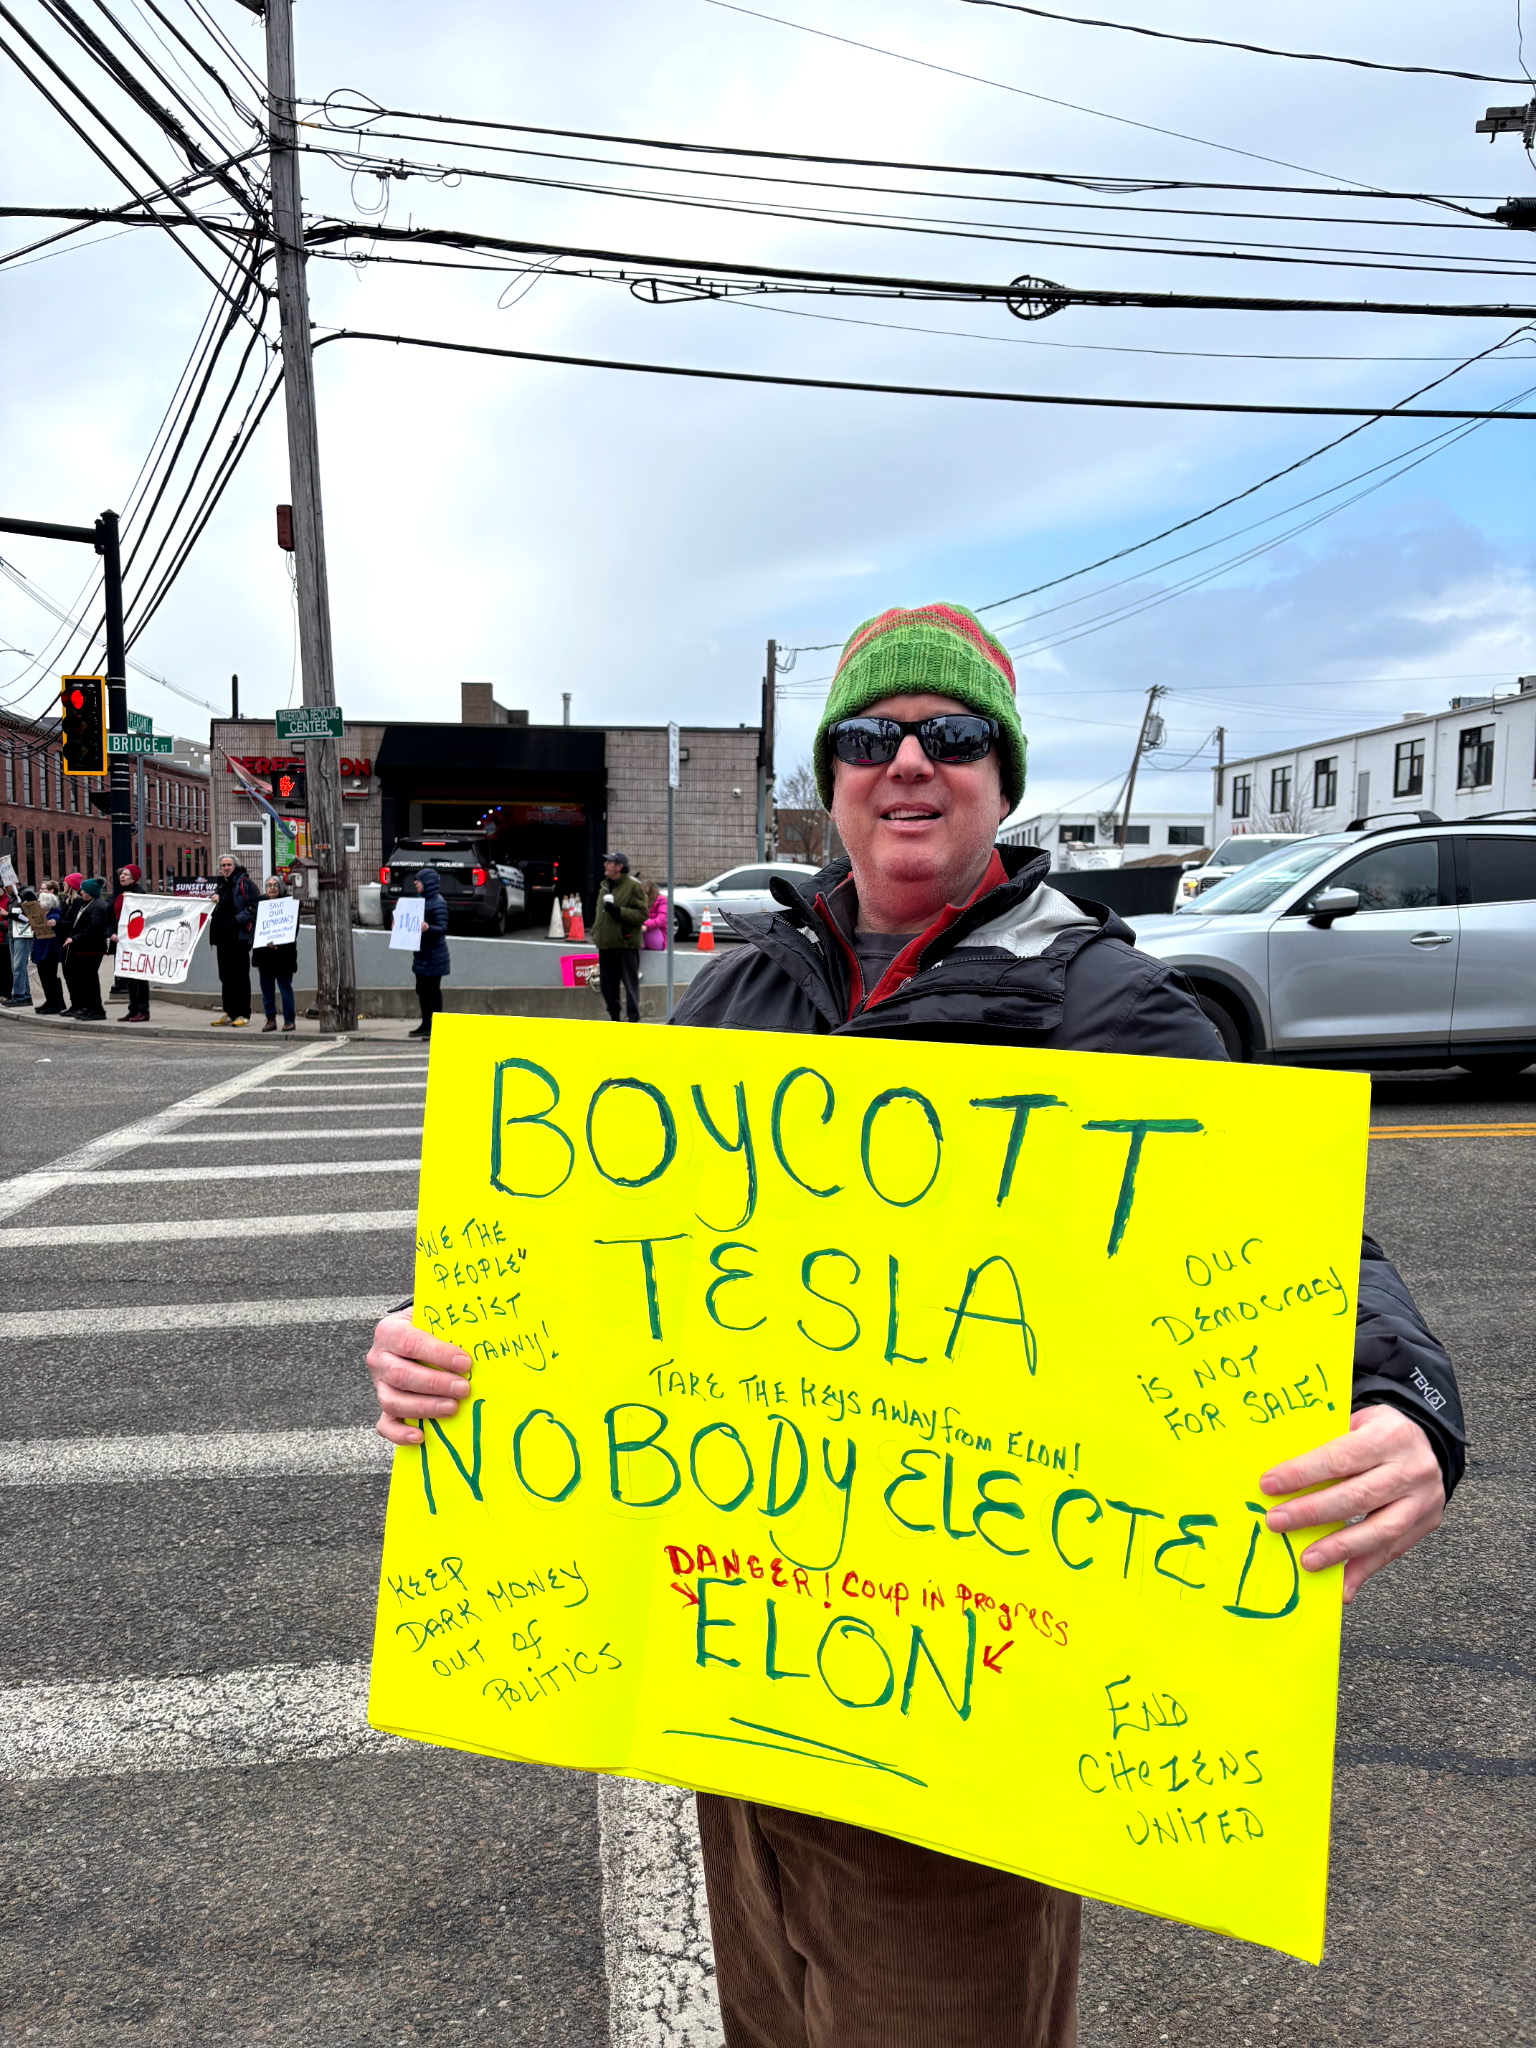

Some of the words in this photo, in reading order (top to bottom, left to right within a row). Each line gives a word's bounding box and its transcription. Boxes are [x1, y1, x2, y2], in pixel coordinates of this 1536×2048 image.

[129, 713, 149, 733] PLEASANT
[278, 710, 309, 722] WATERTOWN
[310, 708, 340, 720] RECYCLING
[289, 721, 329, 733] CENTER
[113, 737, 158, 752] BRIDGE
[161, 744, 168, 752] ST
[175, 883, 204, 891] SUNSET
[145, 927, 175, 949] CUT
[121, 951, 156, 974] ELON
[490, 1057, 1205, 1259] BOYCOTT
[461, 1218, 506, 1248] THE
[594, 1232, 1037, 1376] TESLA
[1193, 1344, 1258, 1389] NOT
[649, 1359, 725, 1400] TAKE
[739, 1374, 789, 1407] THE
[1008, 1431, 1080, 1480] ELON!
[1164, 1403, 1226, 1440] FOR
[1243, 1363, 1335, 1424] SALE!
[418, 1398, 857, 1571] NOBODY
[883, 1449, 1300, 1620] ELECTED
[387, 1556, 469, 1608] KEEP
[395, 1599, 482, 1653] DARK
[487, 1560, 589, 1612] MONEY
[432, 1639, 485, 1676] OUT
[695, 1577, 977, 1721] ELON
[1105, 1674, 1188, 1740] END
